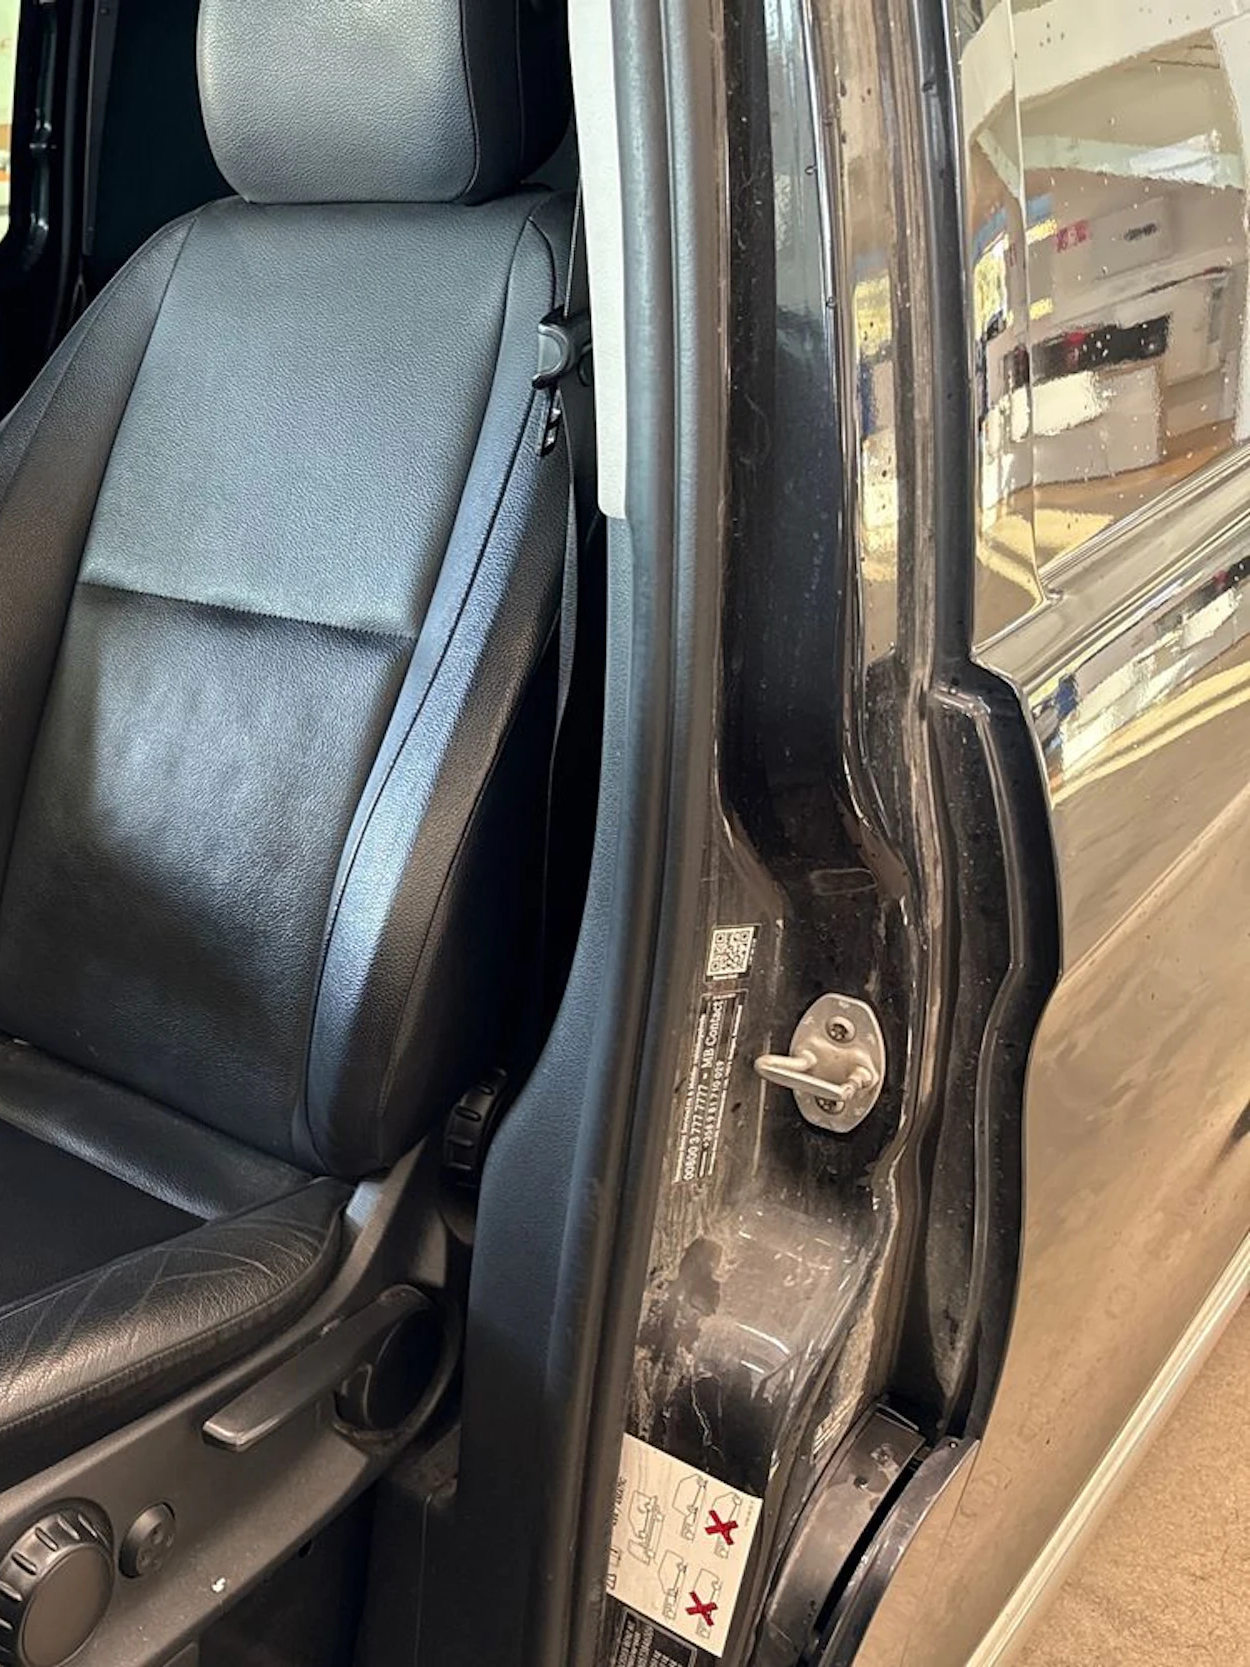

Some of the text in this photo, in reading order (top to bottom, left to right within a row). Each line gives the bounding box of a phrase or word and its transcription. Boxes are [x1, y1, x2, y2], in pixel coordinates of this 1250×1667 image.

[705, 1001, 724, 1046] Contact
[701, 1048, 714, 1068] MB
[695, 1084, 708, 1111] 7777
[691, 1114, 703, 1134] 777
[683, 1146, 698, 1180] 00800
